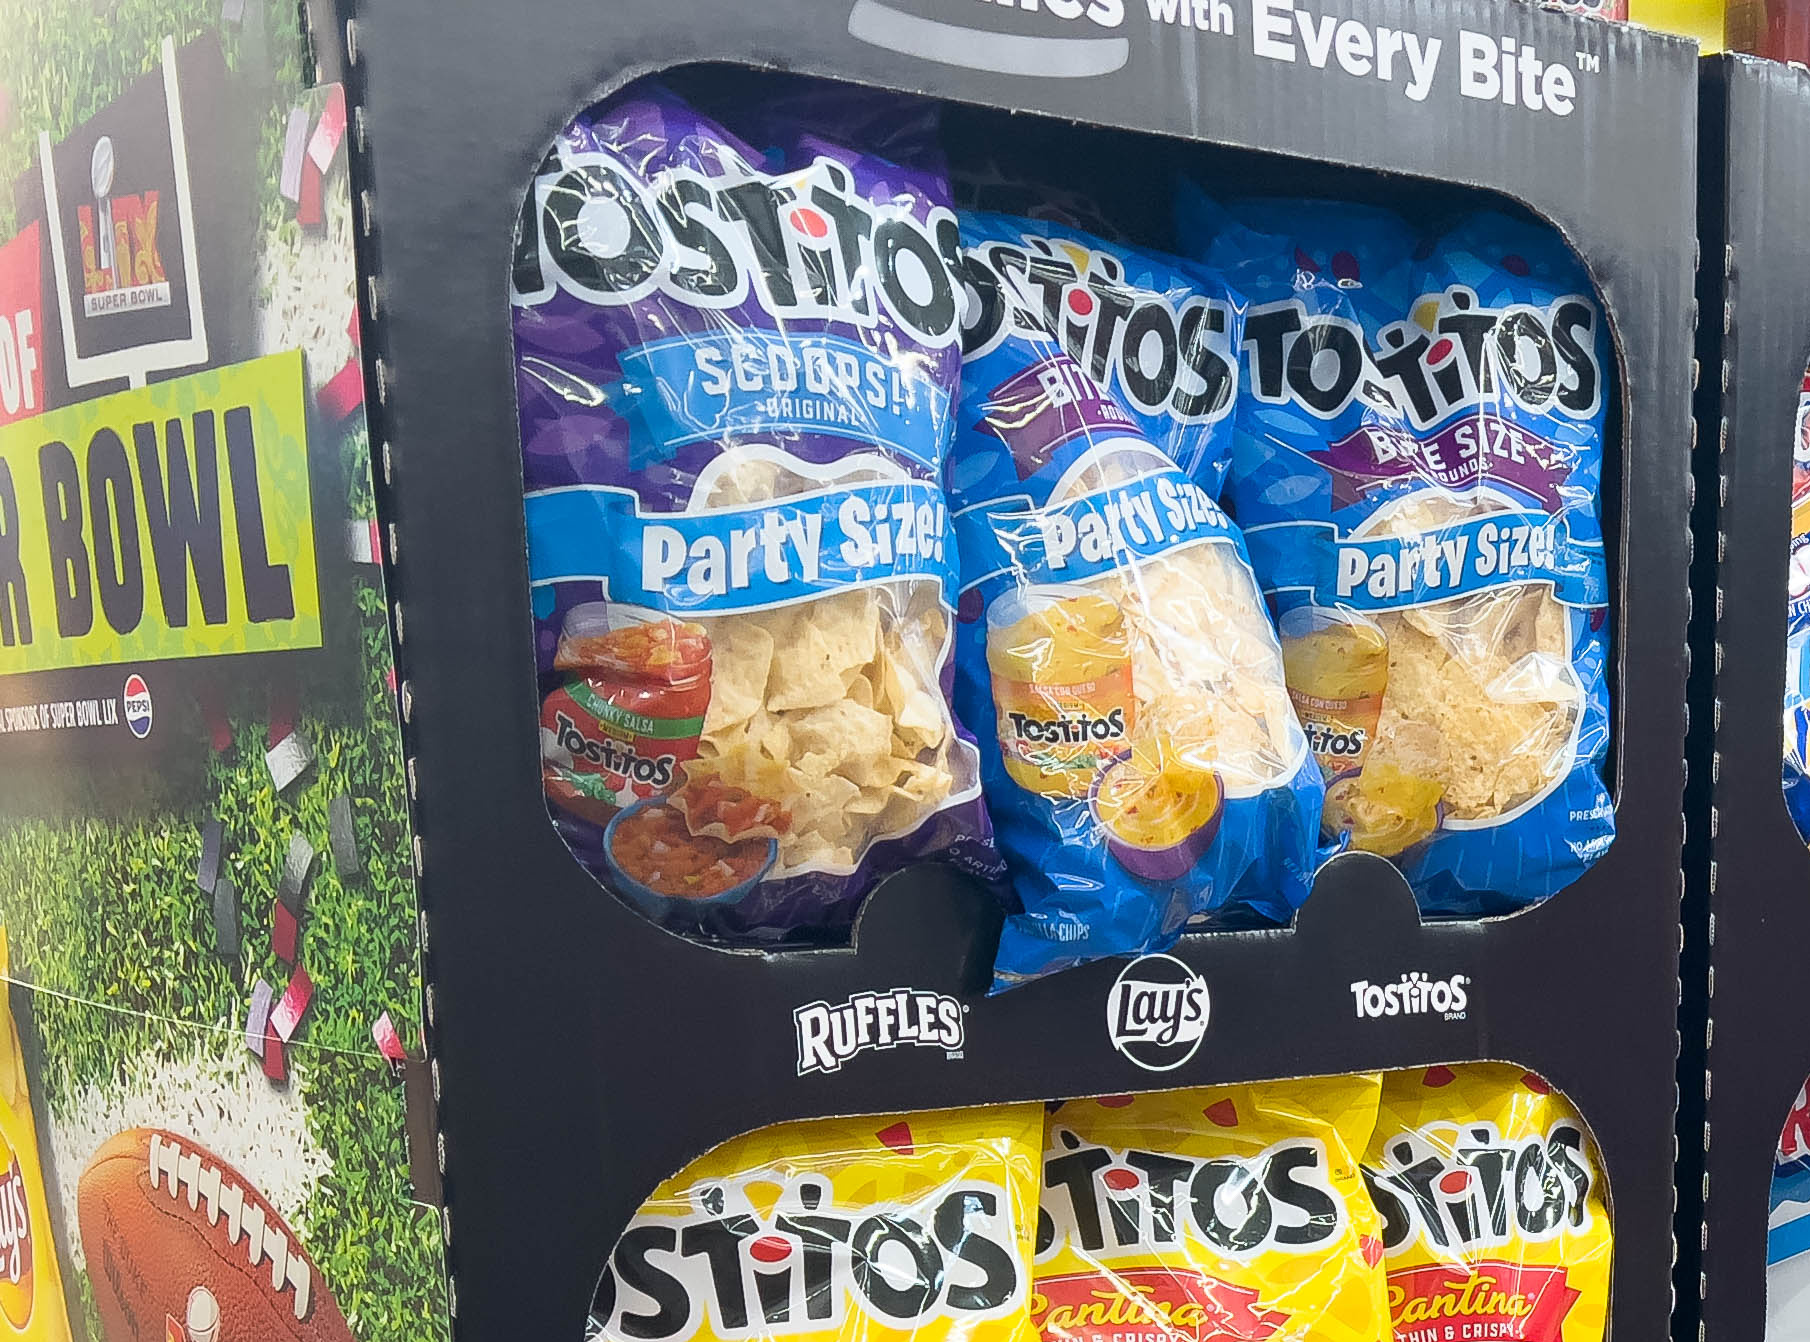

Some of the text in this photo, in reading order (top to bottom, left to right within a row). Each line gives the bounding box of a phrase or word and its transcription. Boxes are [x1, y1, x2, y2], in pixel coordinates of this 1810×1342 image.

[1253, 0, 1440, 101] Every
[1459, 30, 1577, 116] Bite
[90, 288, 164, 312] SUPER BOWL
[766, 398, 863, 426] ORIGINAL
[38, 405, 296, 639] BOWL
[642, 496, 945, 595] Party Size!
[1044, 476, 1229, 560] Party Size!
[1336, 518, 1556, 598] Party Size!
[51, 700, 76, 728] SUPER
[77, 699, 102, 726] BOWL
[127, 699, 150, 713] PEPSI
[587, 694, 654, 733] CHUNKY SALSA
[798, 990, 963, 1072] RUFFLES
[1115, 977, 1205, 1047] Lay's
[1028, 1277, 1208, 1334] Cantina
[1463, 1323, 1516, 1338] CRISPY
